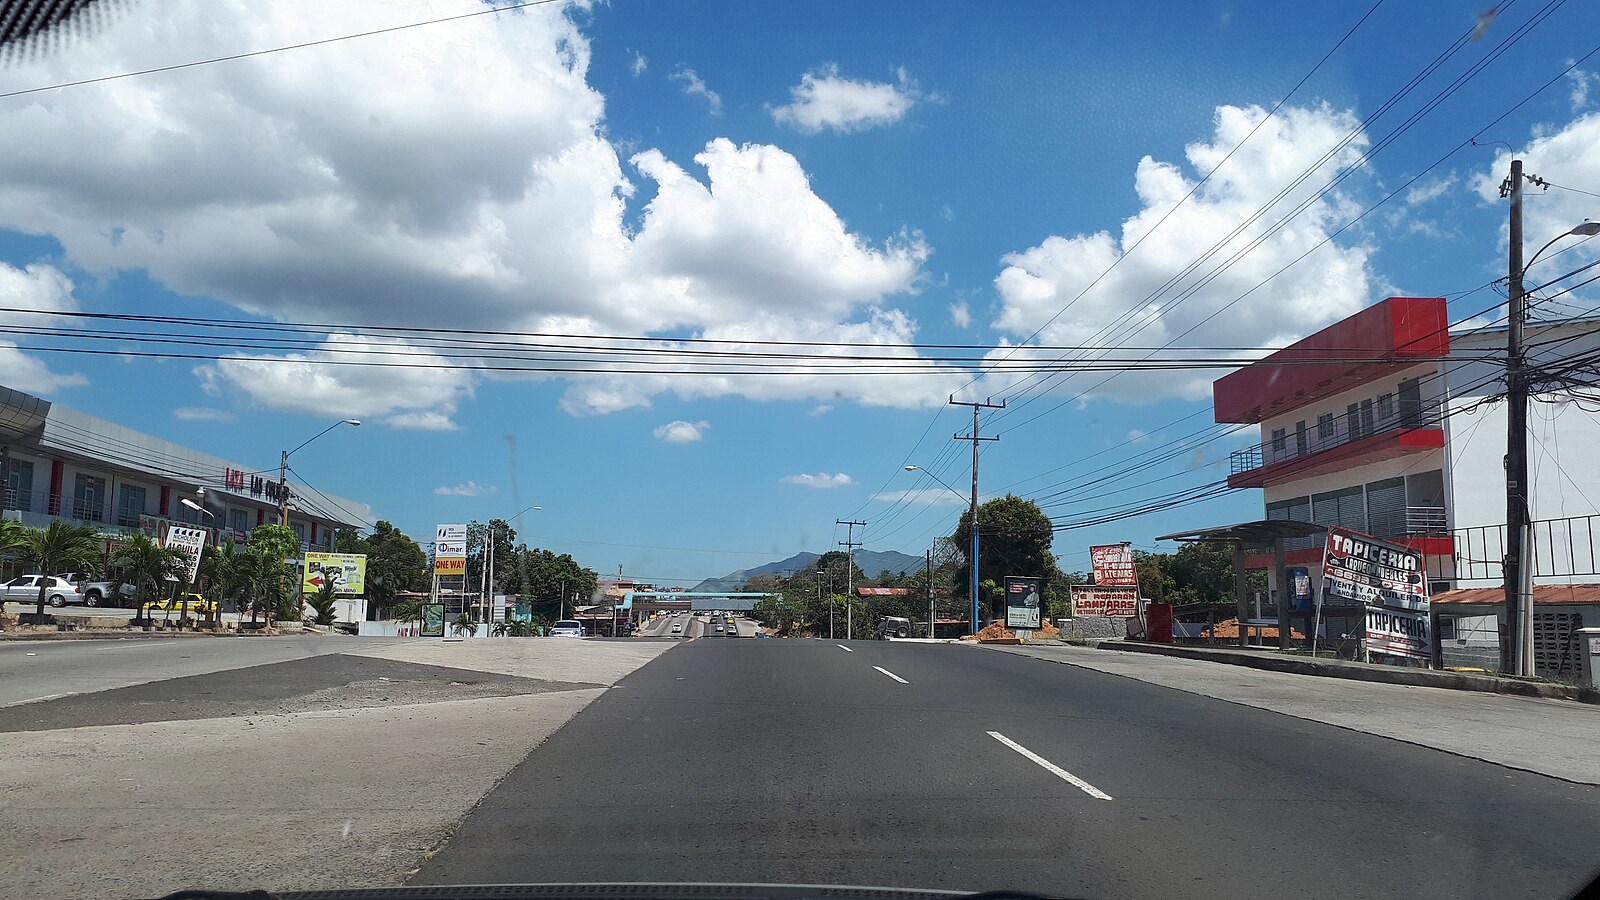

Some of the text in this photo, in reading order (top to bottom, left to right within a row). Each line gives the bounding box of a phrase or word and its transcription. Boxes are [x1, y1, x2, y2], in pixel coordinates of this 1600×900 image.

[1333, 534, 1416, 571] TAPICERIA
[436, 561, 465, 569] ONE WAY
[1333, 580, 1428, 603] VENTA Y ALQUILER DE
[1337, 590, 1372, 602] ANDAMIOS
[1368, 611, 1426, 638] TAPICERIA
